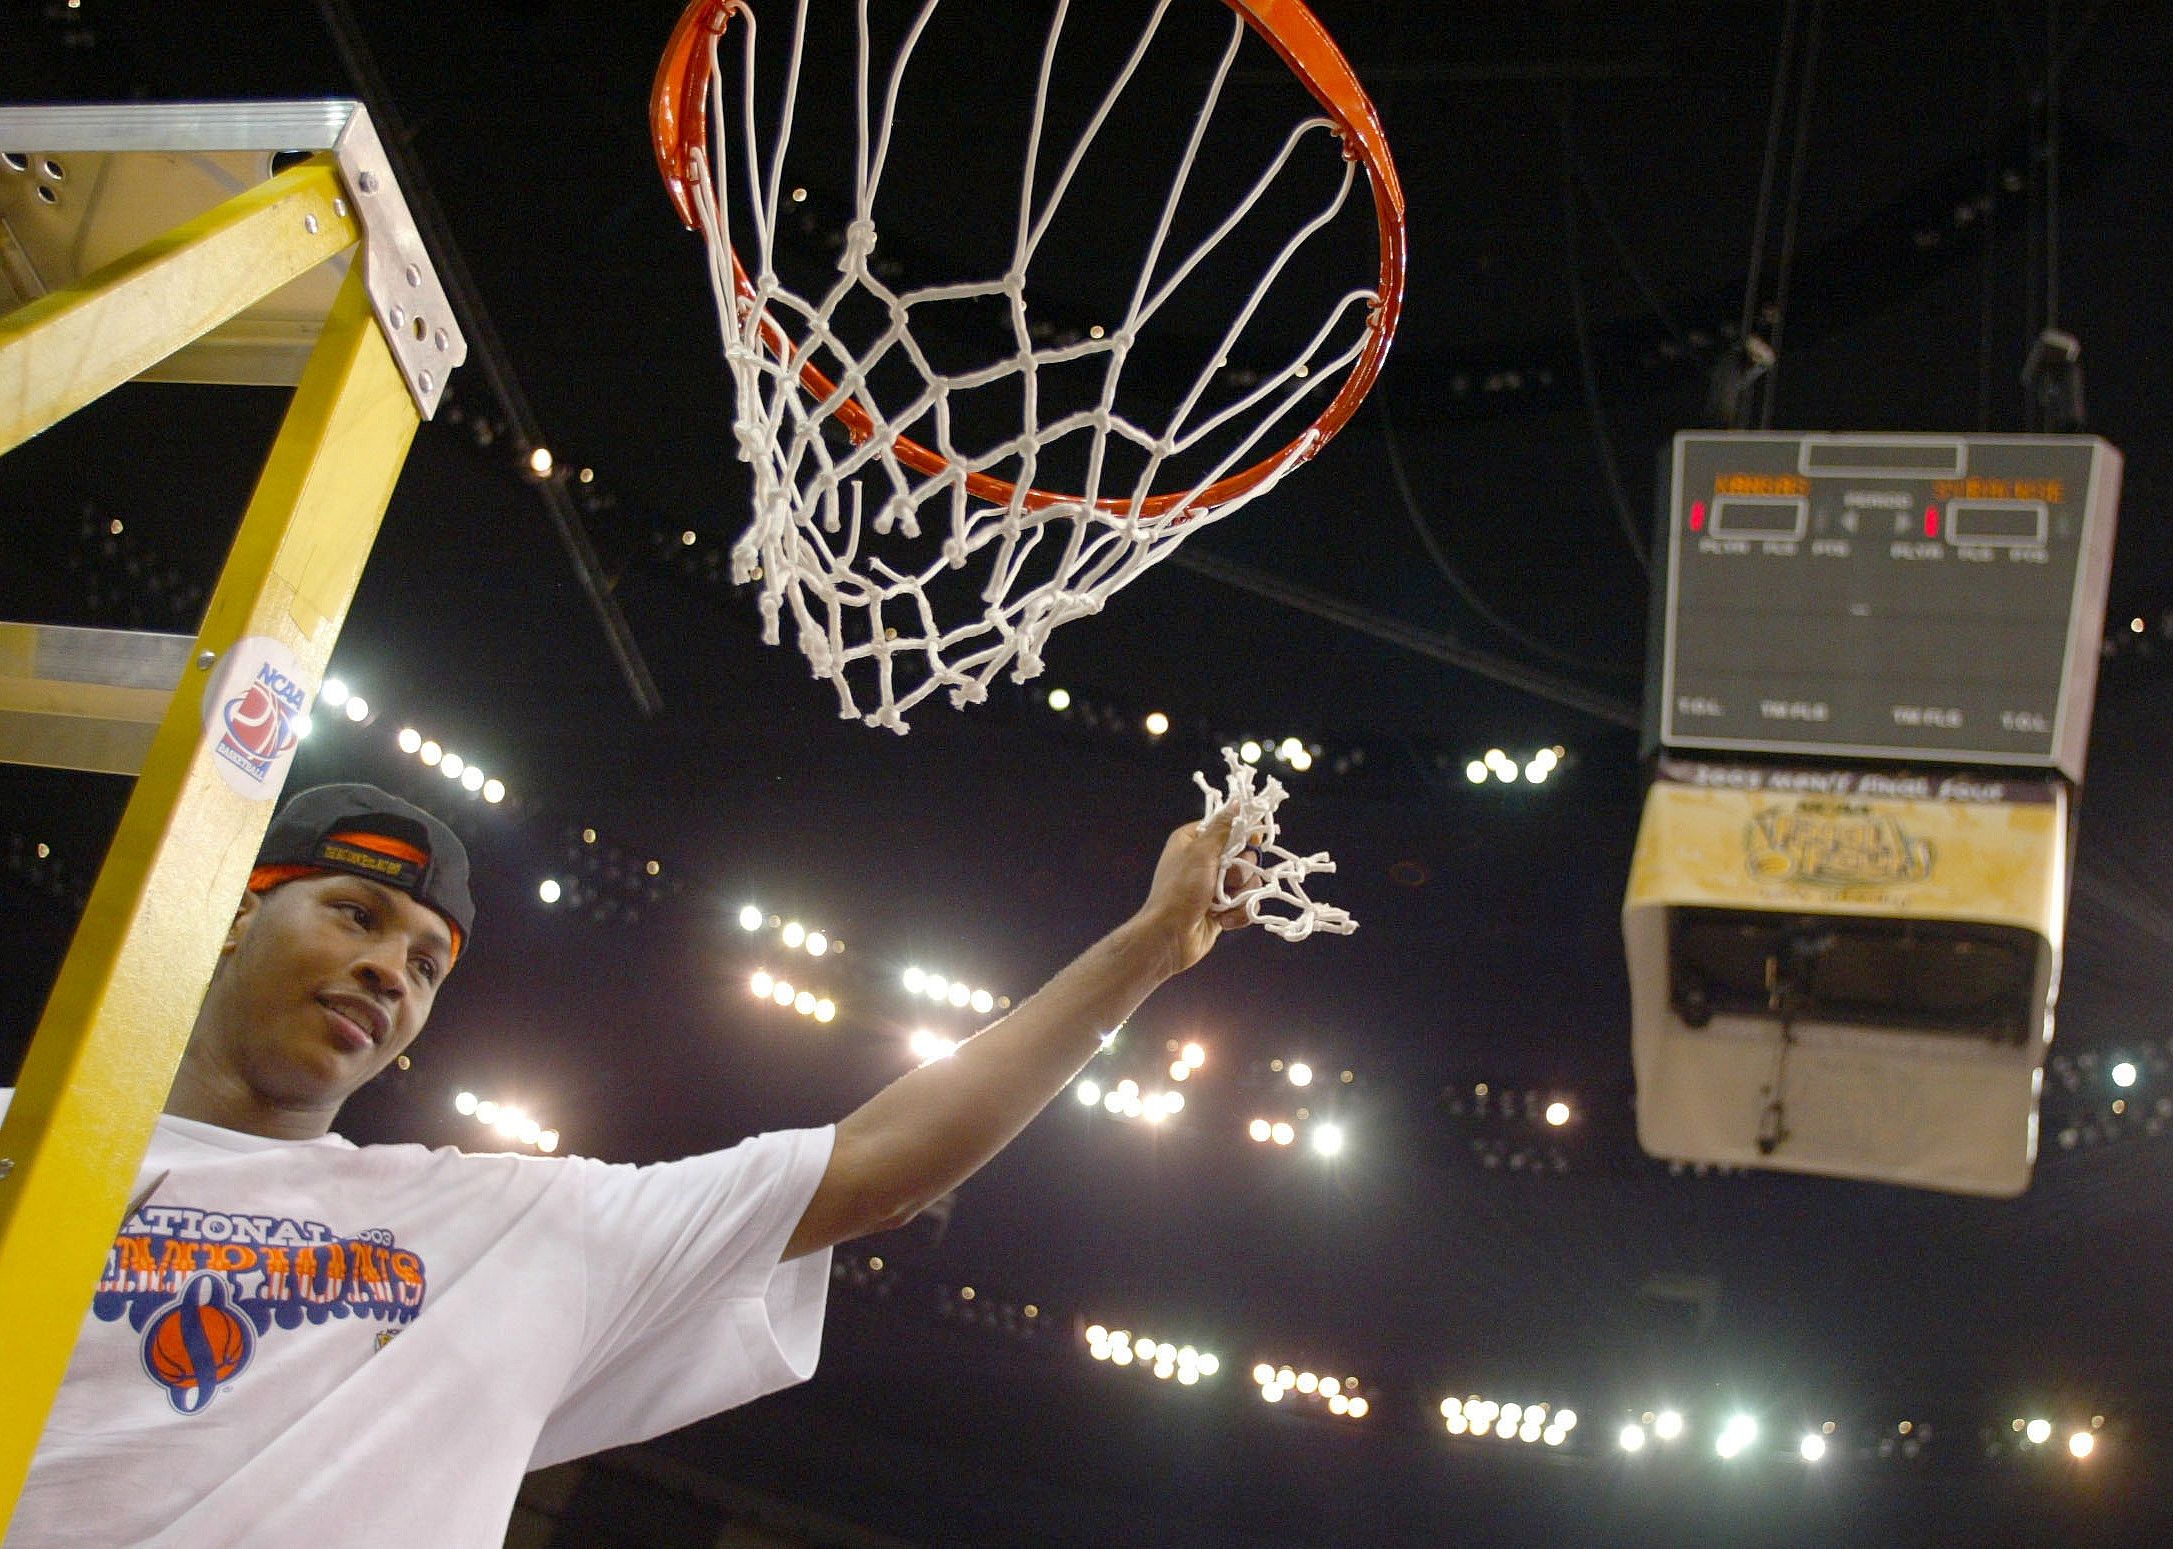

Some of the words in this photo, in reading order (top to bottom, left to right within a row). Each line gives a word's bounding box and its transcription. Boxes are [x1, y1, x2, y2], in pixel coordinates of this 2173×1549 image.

[256, 662, 305, 711] NCAA
[119, 1206, 342, 1249] ATIONAL
[348, 1229, 394, 1248] 003
[97, 1235, 423, 1306] MPIONS
